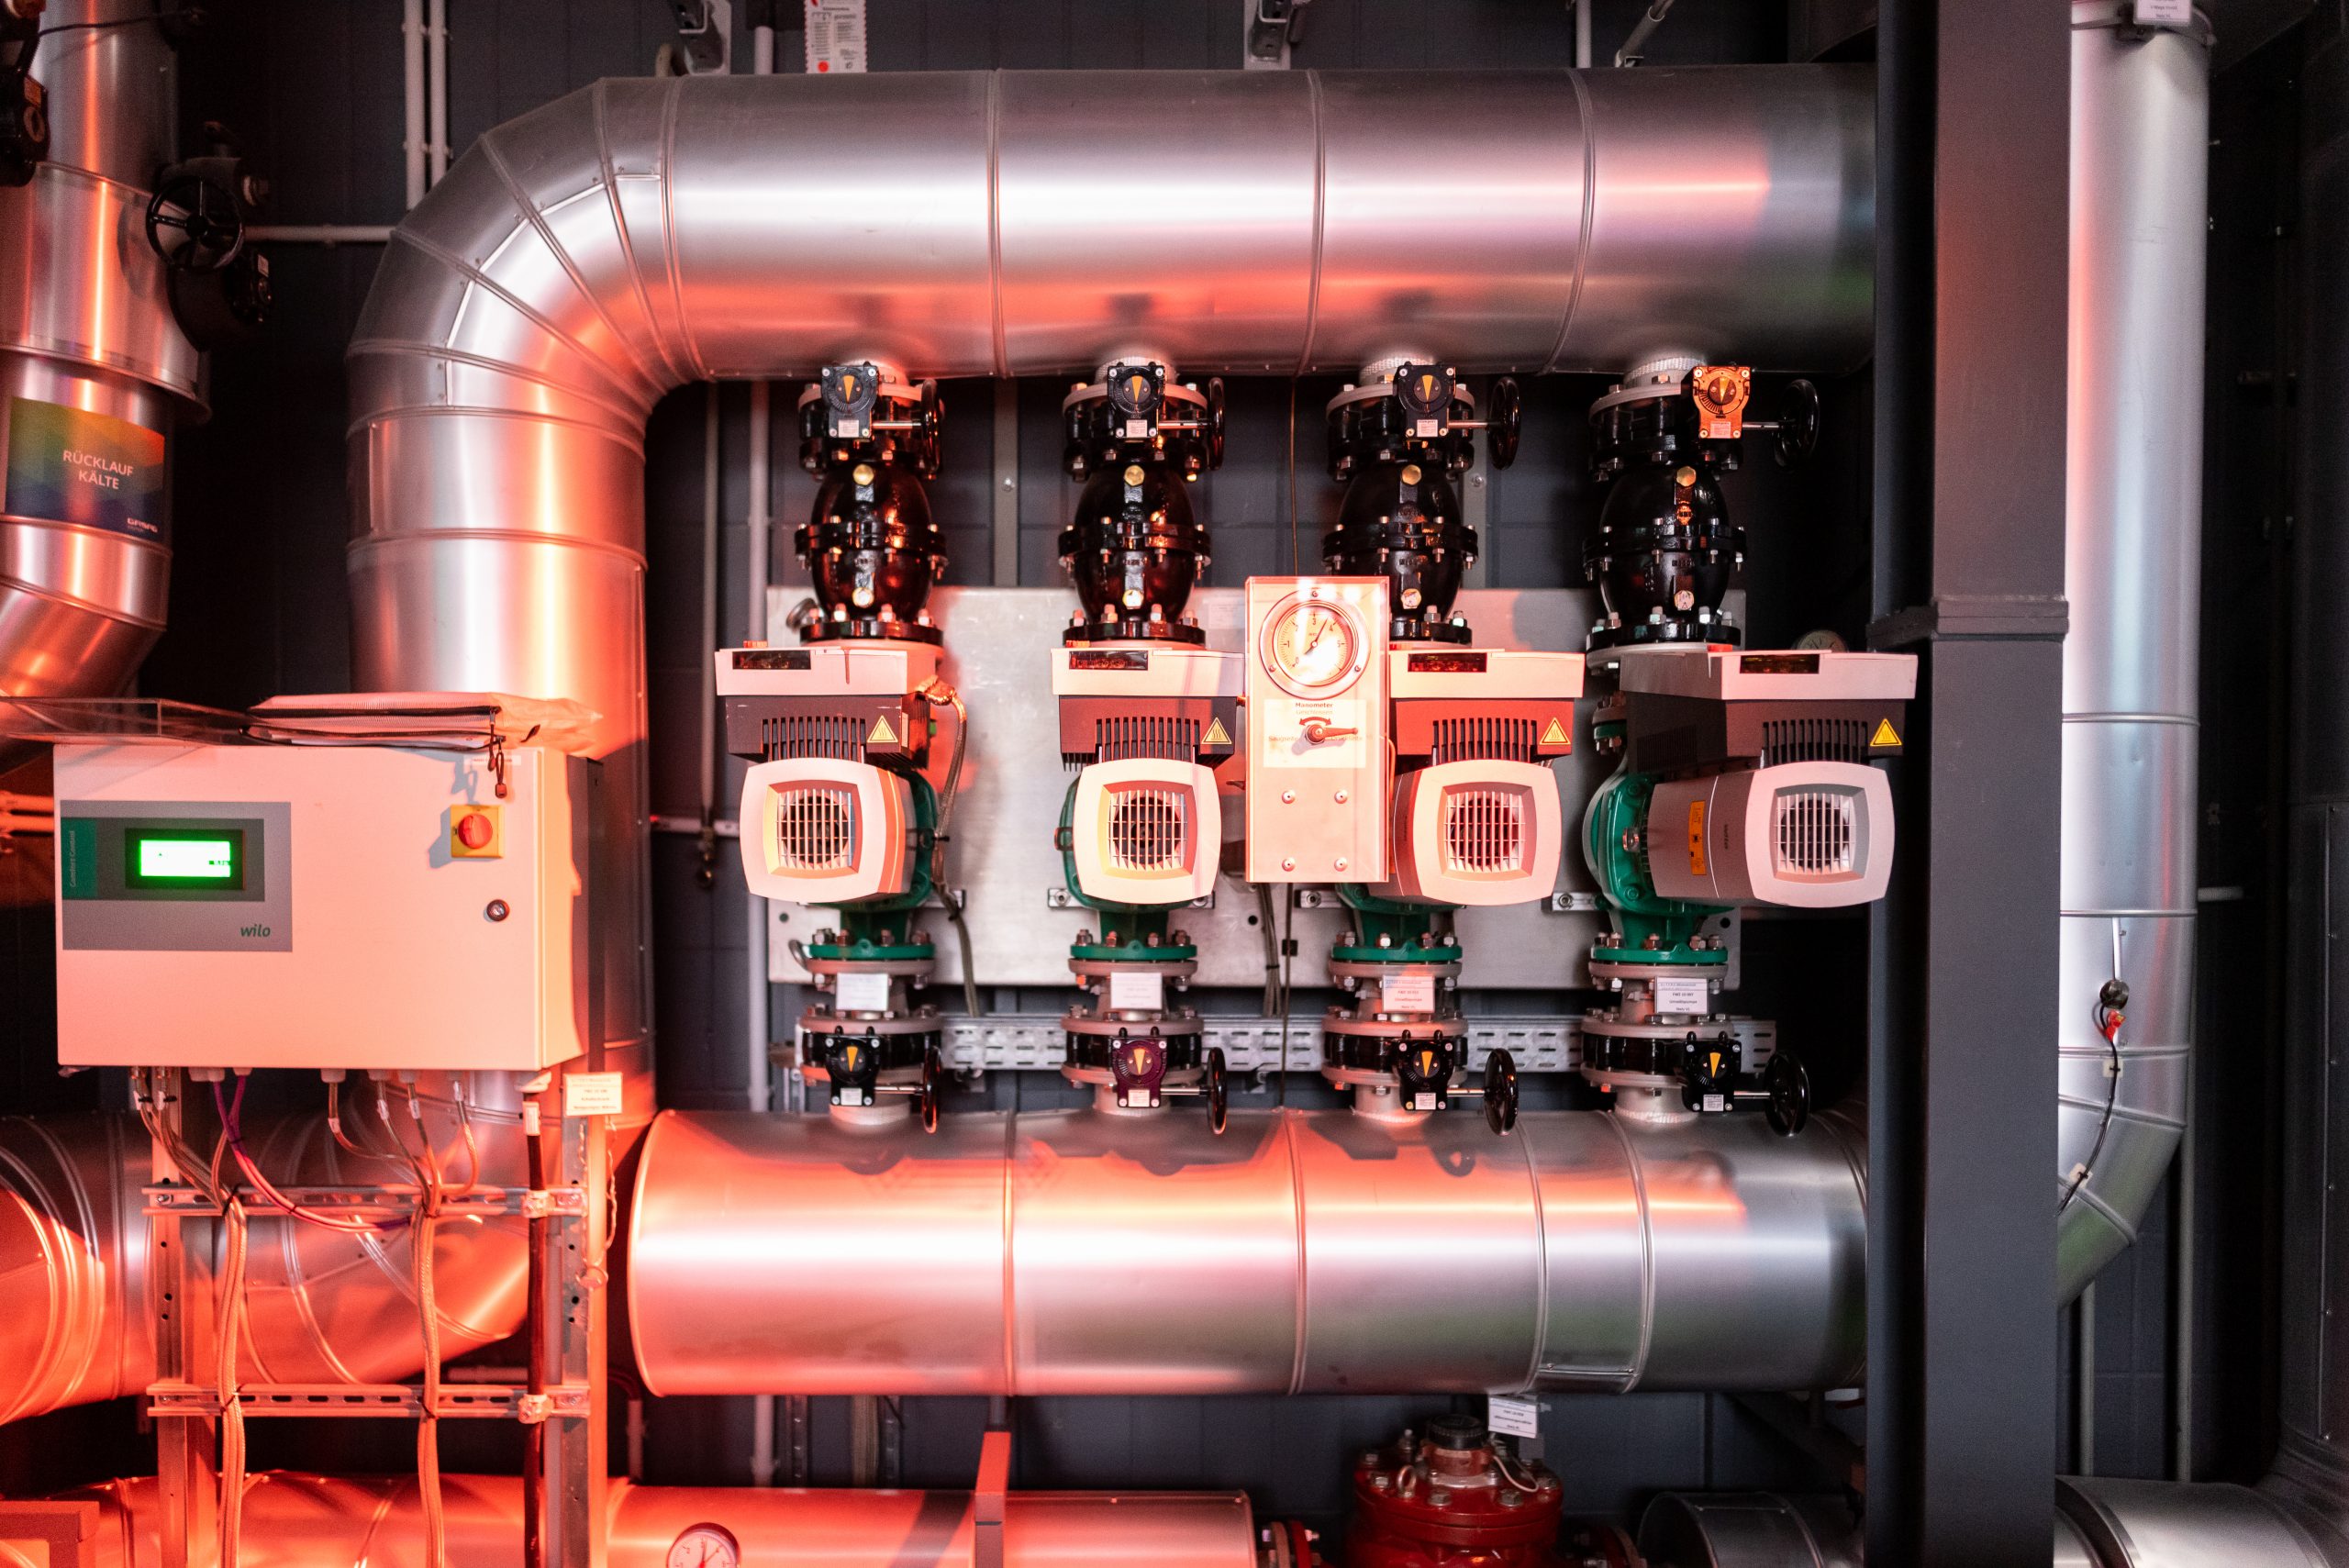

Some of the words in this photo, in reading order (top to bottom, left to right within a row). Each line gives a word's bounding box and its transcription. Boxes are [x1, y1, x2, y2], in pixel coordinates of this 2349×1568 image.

[62, 450, 134, 476] RÜCKLAUF
[79, 470, 119, 490] KÄLTE
[239, 923, 272, 938] wilo
